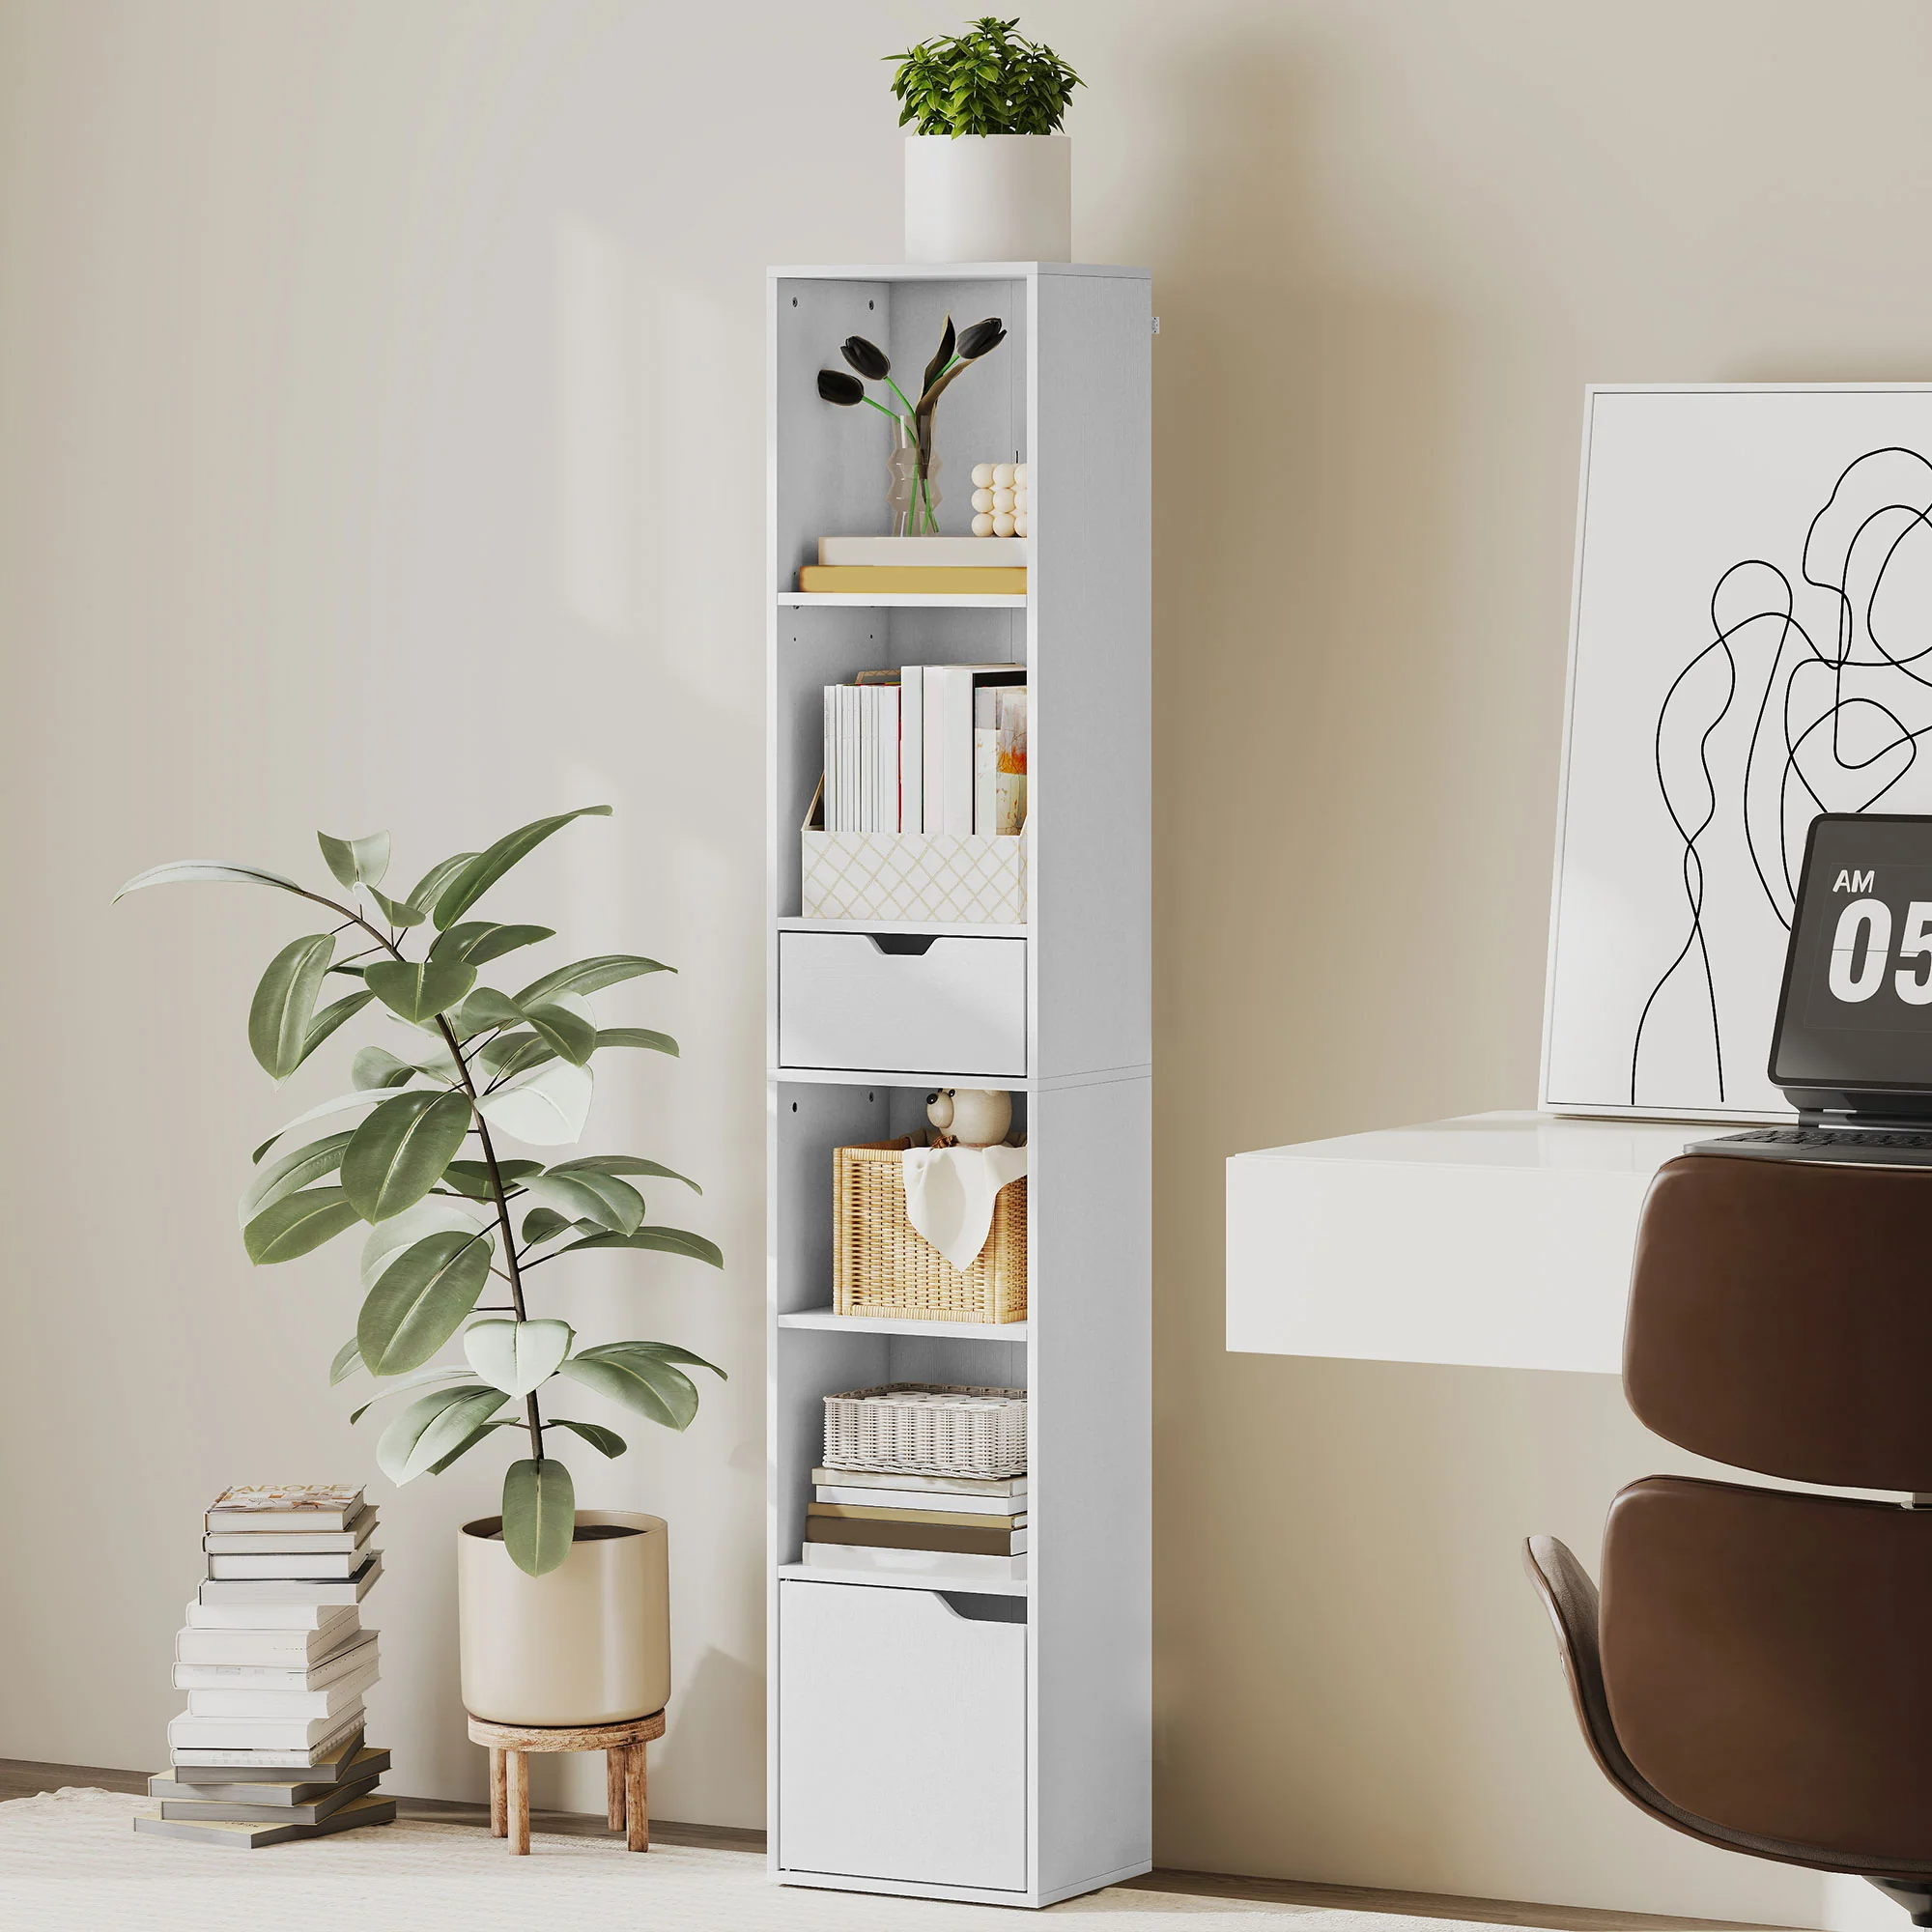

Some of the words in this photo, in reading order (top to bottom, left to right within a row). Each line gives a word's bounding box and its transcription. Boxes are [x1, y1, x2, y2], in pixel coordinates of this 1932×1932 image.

[1833, 869, 1875, 893] AM
[1829, 898, 1932, 1005] 05
[236, 1484, 353, 1492] ABODE
